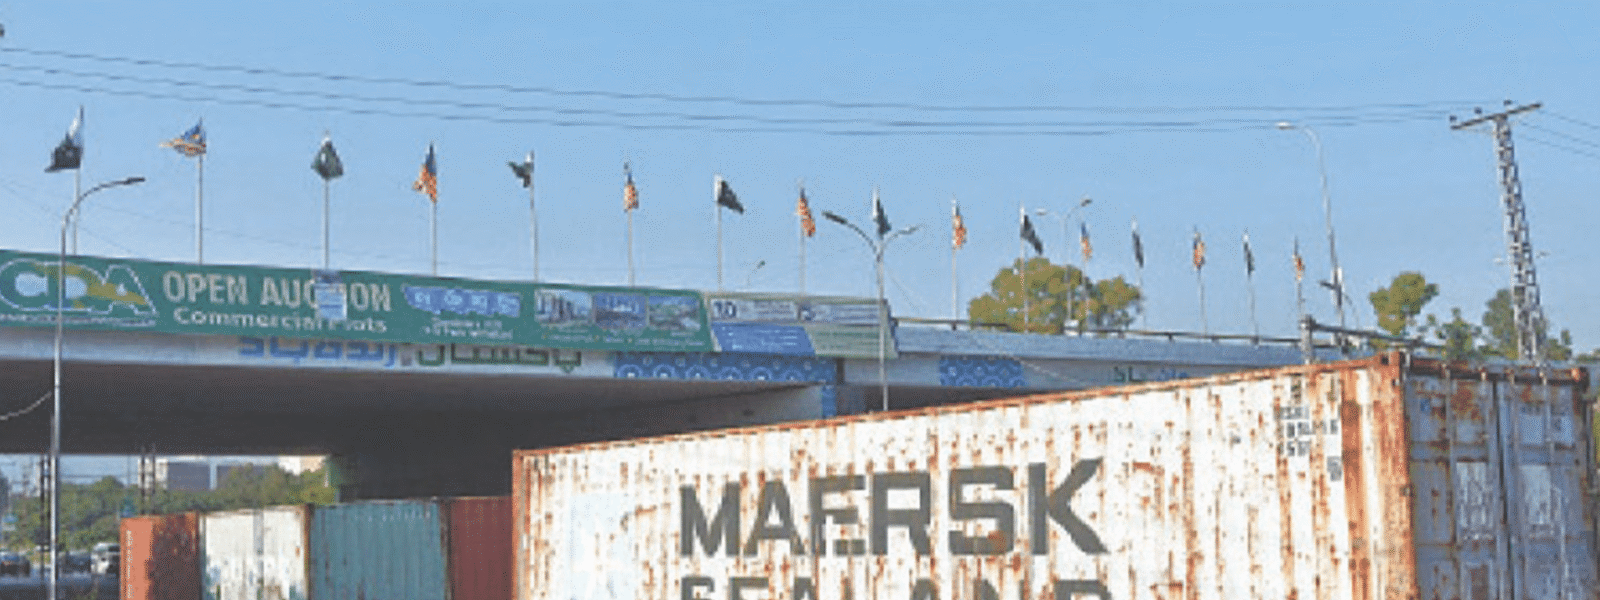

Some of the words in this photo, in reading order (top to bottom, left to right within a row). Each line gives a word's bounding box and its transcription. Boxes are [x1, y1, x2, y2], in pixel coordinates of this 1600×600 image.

[162, 270, 248, 304] OPEN
[260, 276, 392, 313] AUCON
[173, 307, 323, 331] Commercial
[679, 456, 1112, 556] MAERSK
